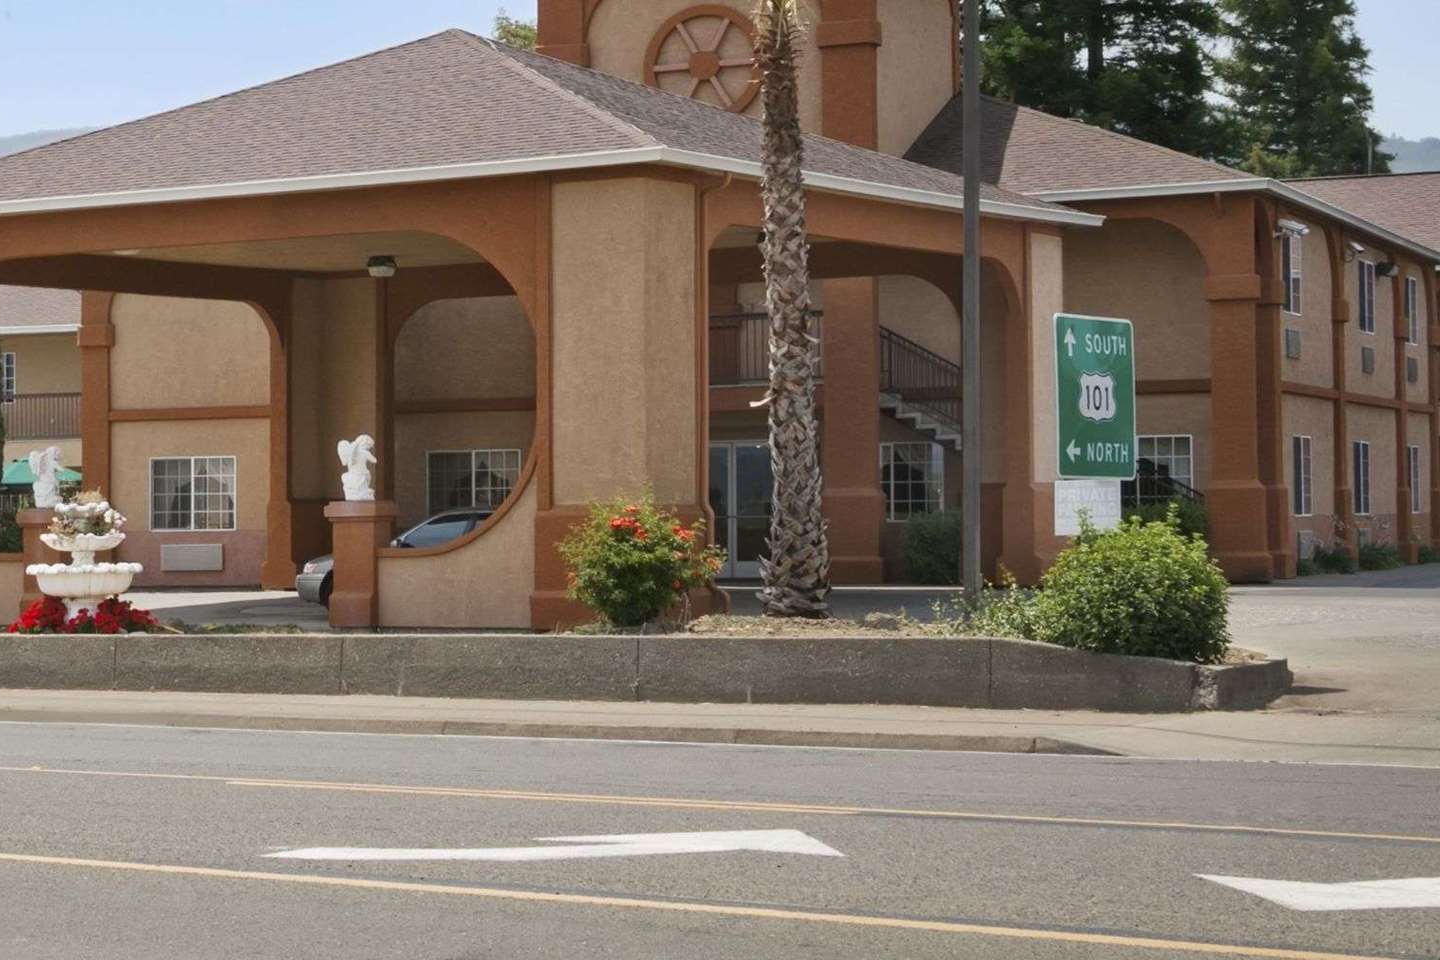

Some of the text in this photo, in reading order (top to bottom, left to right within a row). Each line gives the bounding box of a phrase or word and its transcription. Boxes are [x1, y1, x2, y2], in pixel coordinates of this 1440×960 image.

[1085, 333, 1127, 356] SOUTH
[1085, 385, 1110, 411] 101
[1087, 442, 1129, 463] NORTH
[1058, 487, 1117, 501] PRIVATE
